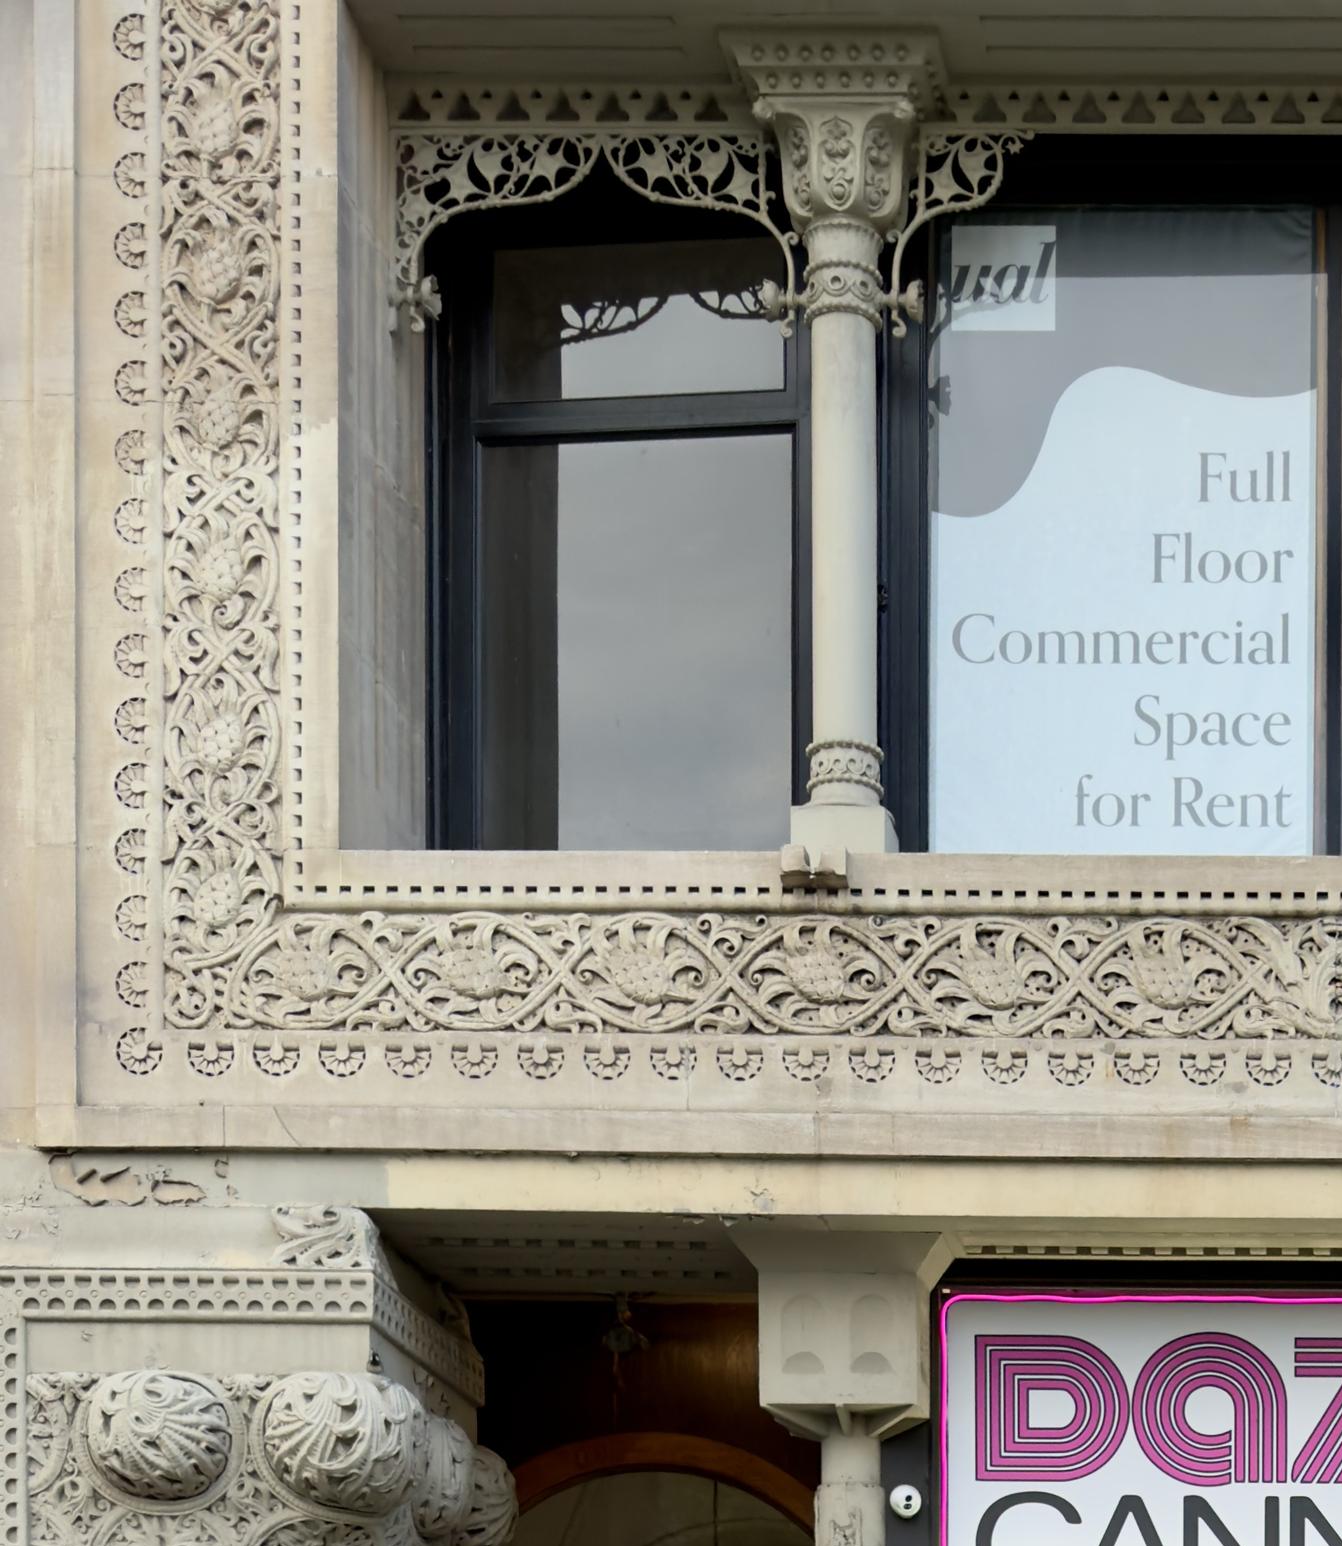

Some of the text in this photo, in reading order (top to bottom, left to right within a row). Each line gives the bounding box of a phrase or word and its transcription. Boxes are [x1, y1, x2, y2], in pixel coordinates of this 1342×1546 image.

[951, 241, 1056, 304] ual
[1197, 450, 1292, 504] Full
[1151, 532, 1294, 585] Floor
[952, 613, 1292, 666] Commercial
[1133, 694, 1292, 761] Space
[1074, 774, 1293, 829] for Rent
